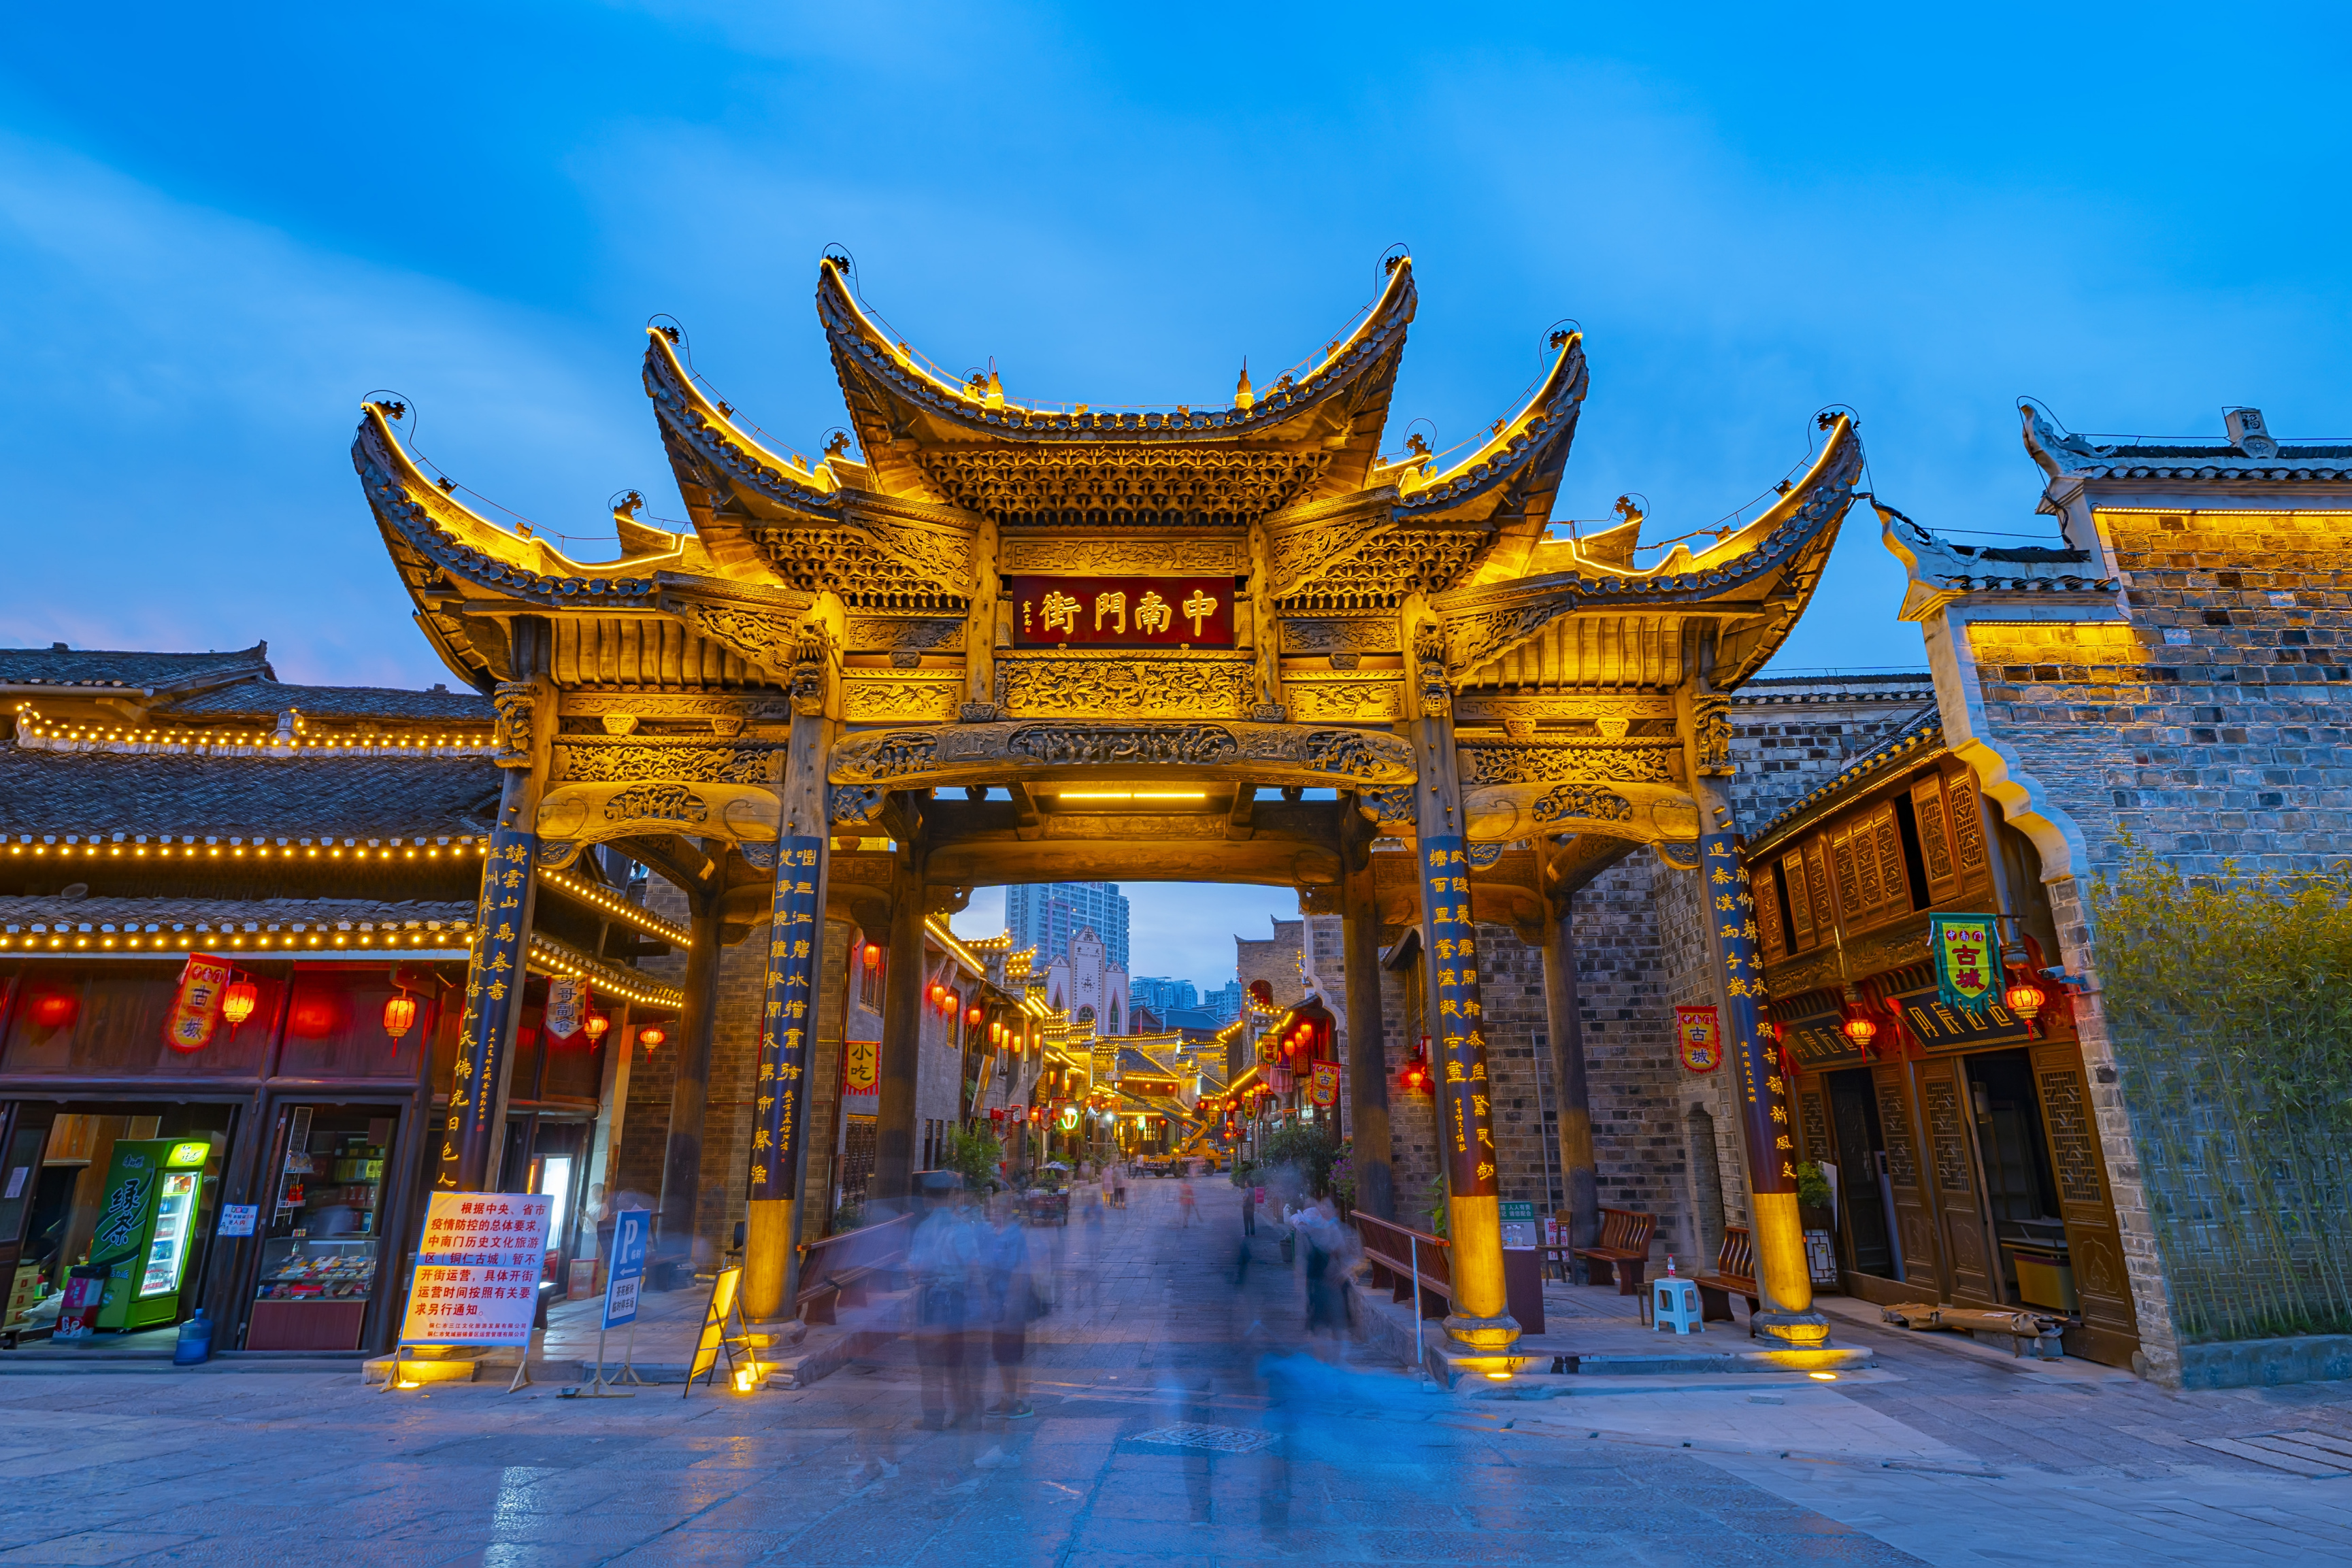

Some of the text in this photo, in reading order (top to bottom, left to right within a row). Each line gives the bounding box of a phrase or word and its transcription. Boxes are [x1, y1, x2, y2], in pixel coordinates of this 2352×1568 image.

[1947, 929, 1982, 942] 中南门
[194, 965, 222, 983] 中南门
[1951, 944, 1986, 990] 古城
[182, 984, 212, 1041] 古城
[1684, 1014, 1711, 1024] 中南门
[1689, 1026, 1711, 1065] 古城
[850, 1044, 874, 1081] 小吃
[1316, 1074, 1331, 1101] 古城
[101, 1178, 140, 1246] 绿茶
[428, 1235, 540, 1249] 中南门历史文化旅游
[619, 1219, 638, 1265] P
[631, 1248, 642, 1261] 临时
[417, 1286, 531, 1299] 运营时间按照有关要
[612, 1297, 635, 1313] 临时停车场
